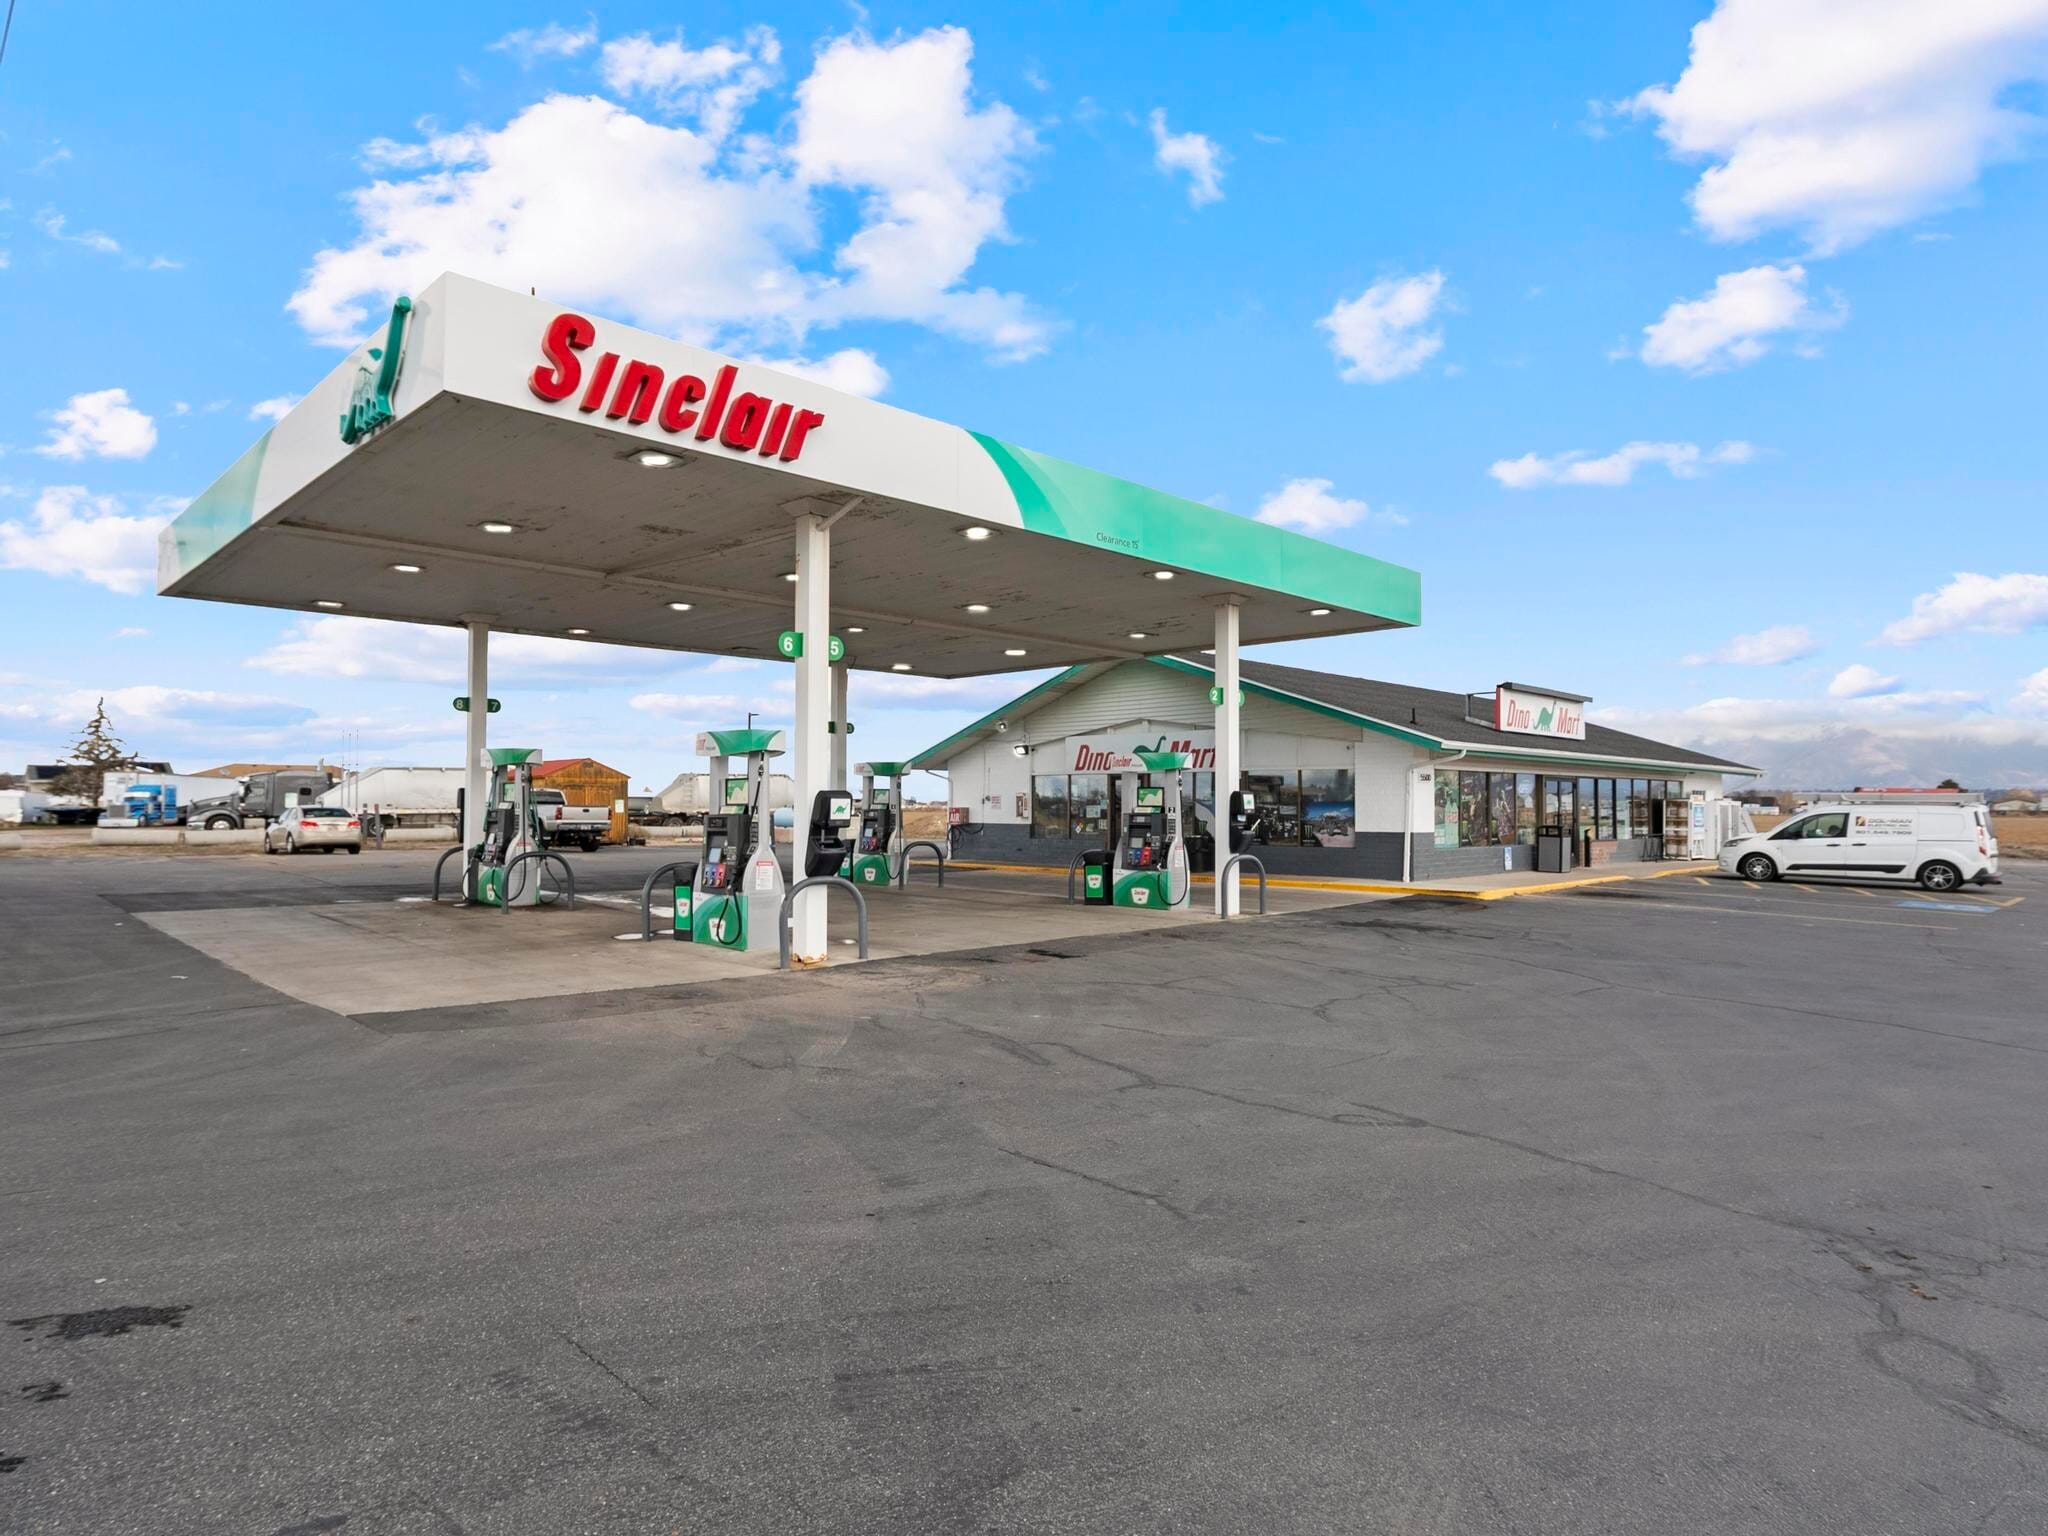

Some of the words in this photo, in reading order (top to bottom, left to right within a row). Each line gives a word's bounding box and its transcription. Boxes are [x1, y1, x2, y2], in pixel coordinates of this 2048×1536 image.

[528, 313, 825, 462] Sinclair
[1096, 532, 1131, 548] Clearance
[783, 637, 793, 652] 6
[830, 641, 839, 655] 5
[1212, 690, 1218, 701] 2
[456, 699, 464, 710] 8
[491, 701, 499, 711] 7
[1507, 700, 1530, 728] Dino
[1557, 707, 1580, 734] Mart
